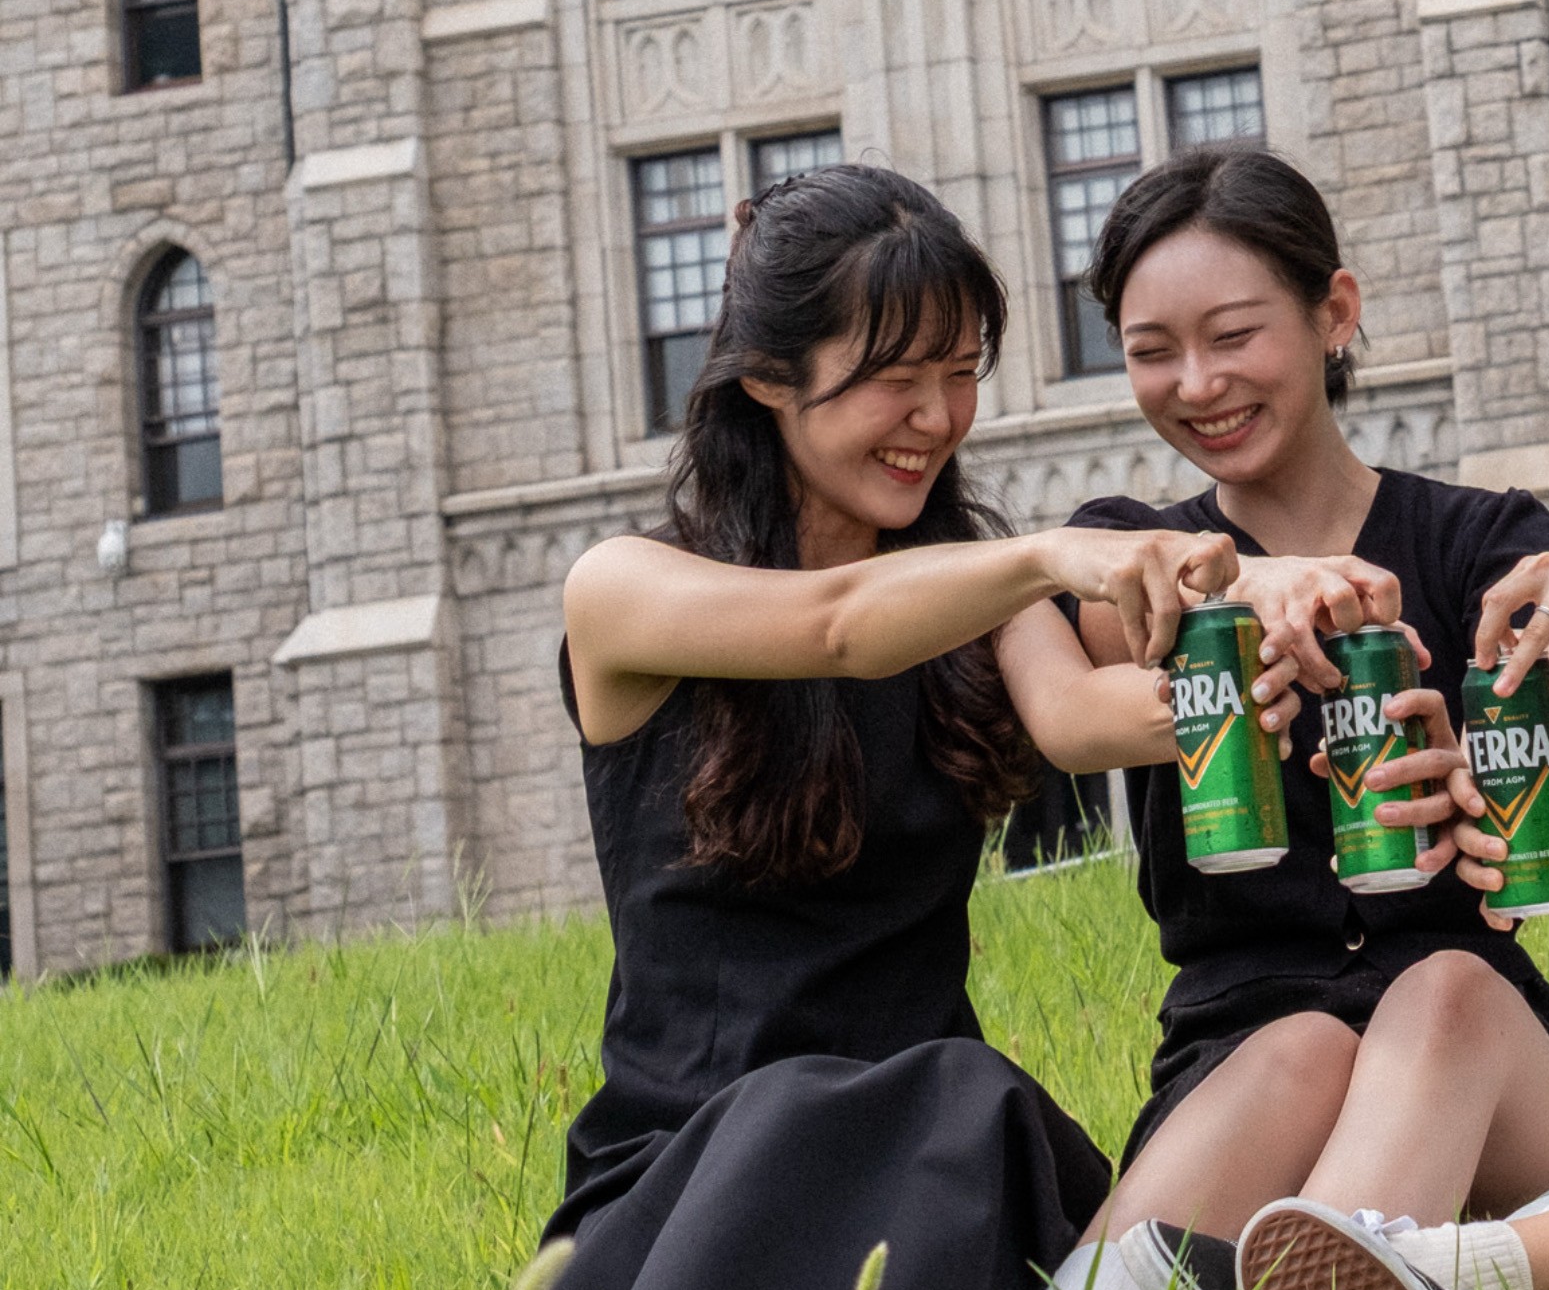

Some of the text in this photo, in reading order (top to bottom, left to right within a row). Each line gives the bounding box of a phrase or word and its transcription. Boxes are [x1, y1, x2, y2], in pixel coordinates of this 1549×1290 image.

[1192, 723, 1209, 732] AGM
[1352, 744, 1371, 752] AGM
[1483, 776, 1525, 787] FROM AGM
